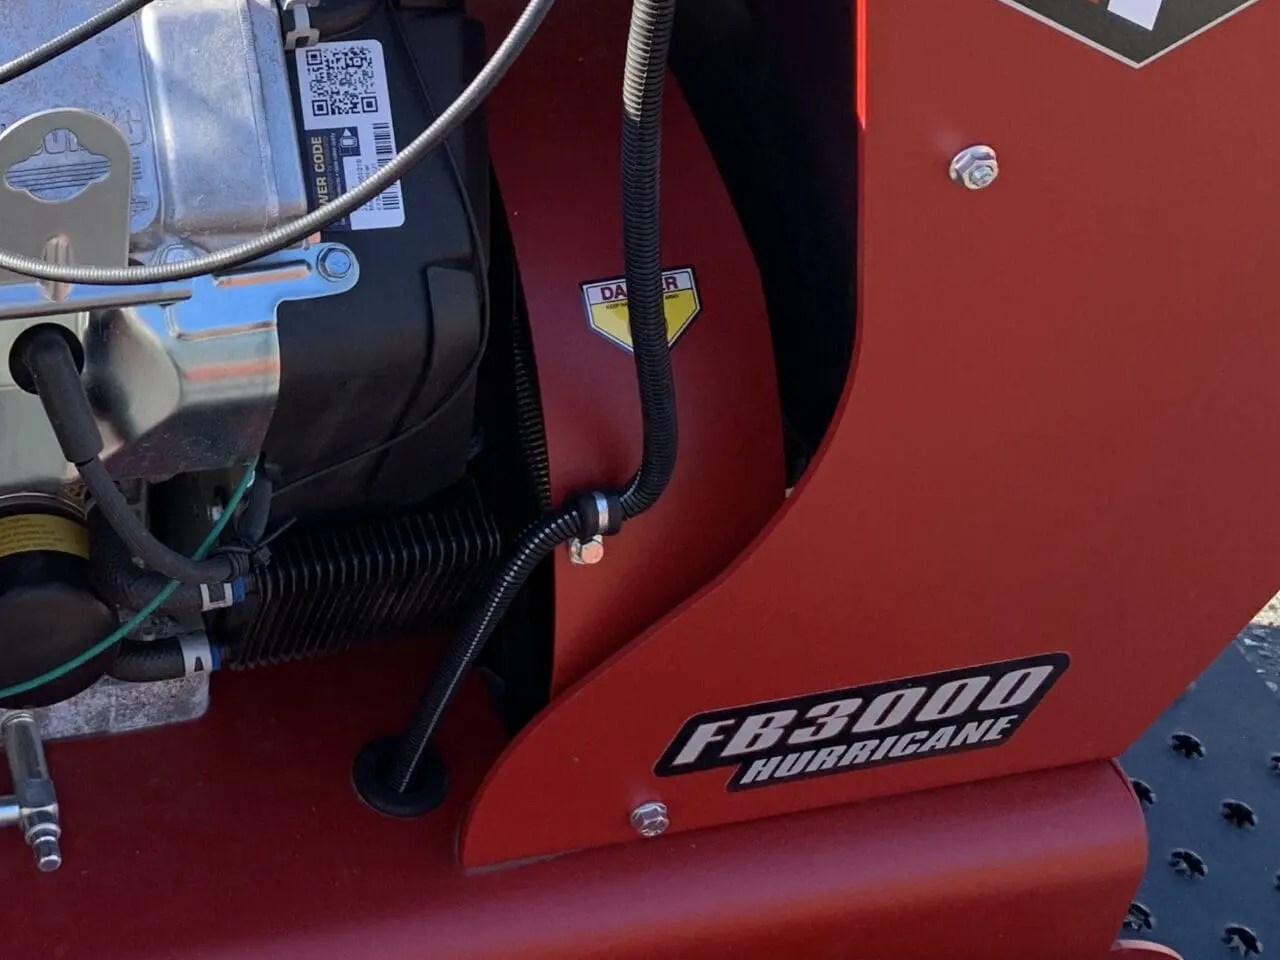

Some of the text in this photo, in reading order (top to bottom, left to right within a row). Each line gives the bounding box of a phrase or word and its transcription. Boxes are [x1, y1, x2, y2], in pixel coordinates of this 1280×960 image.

[311, 135, 325, 173] CODE
[601, 276, 679, 300] DAR
[671, 665, 1055, 767] FB3000
[739, 714, 1019, 785] HURRICANE
